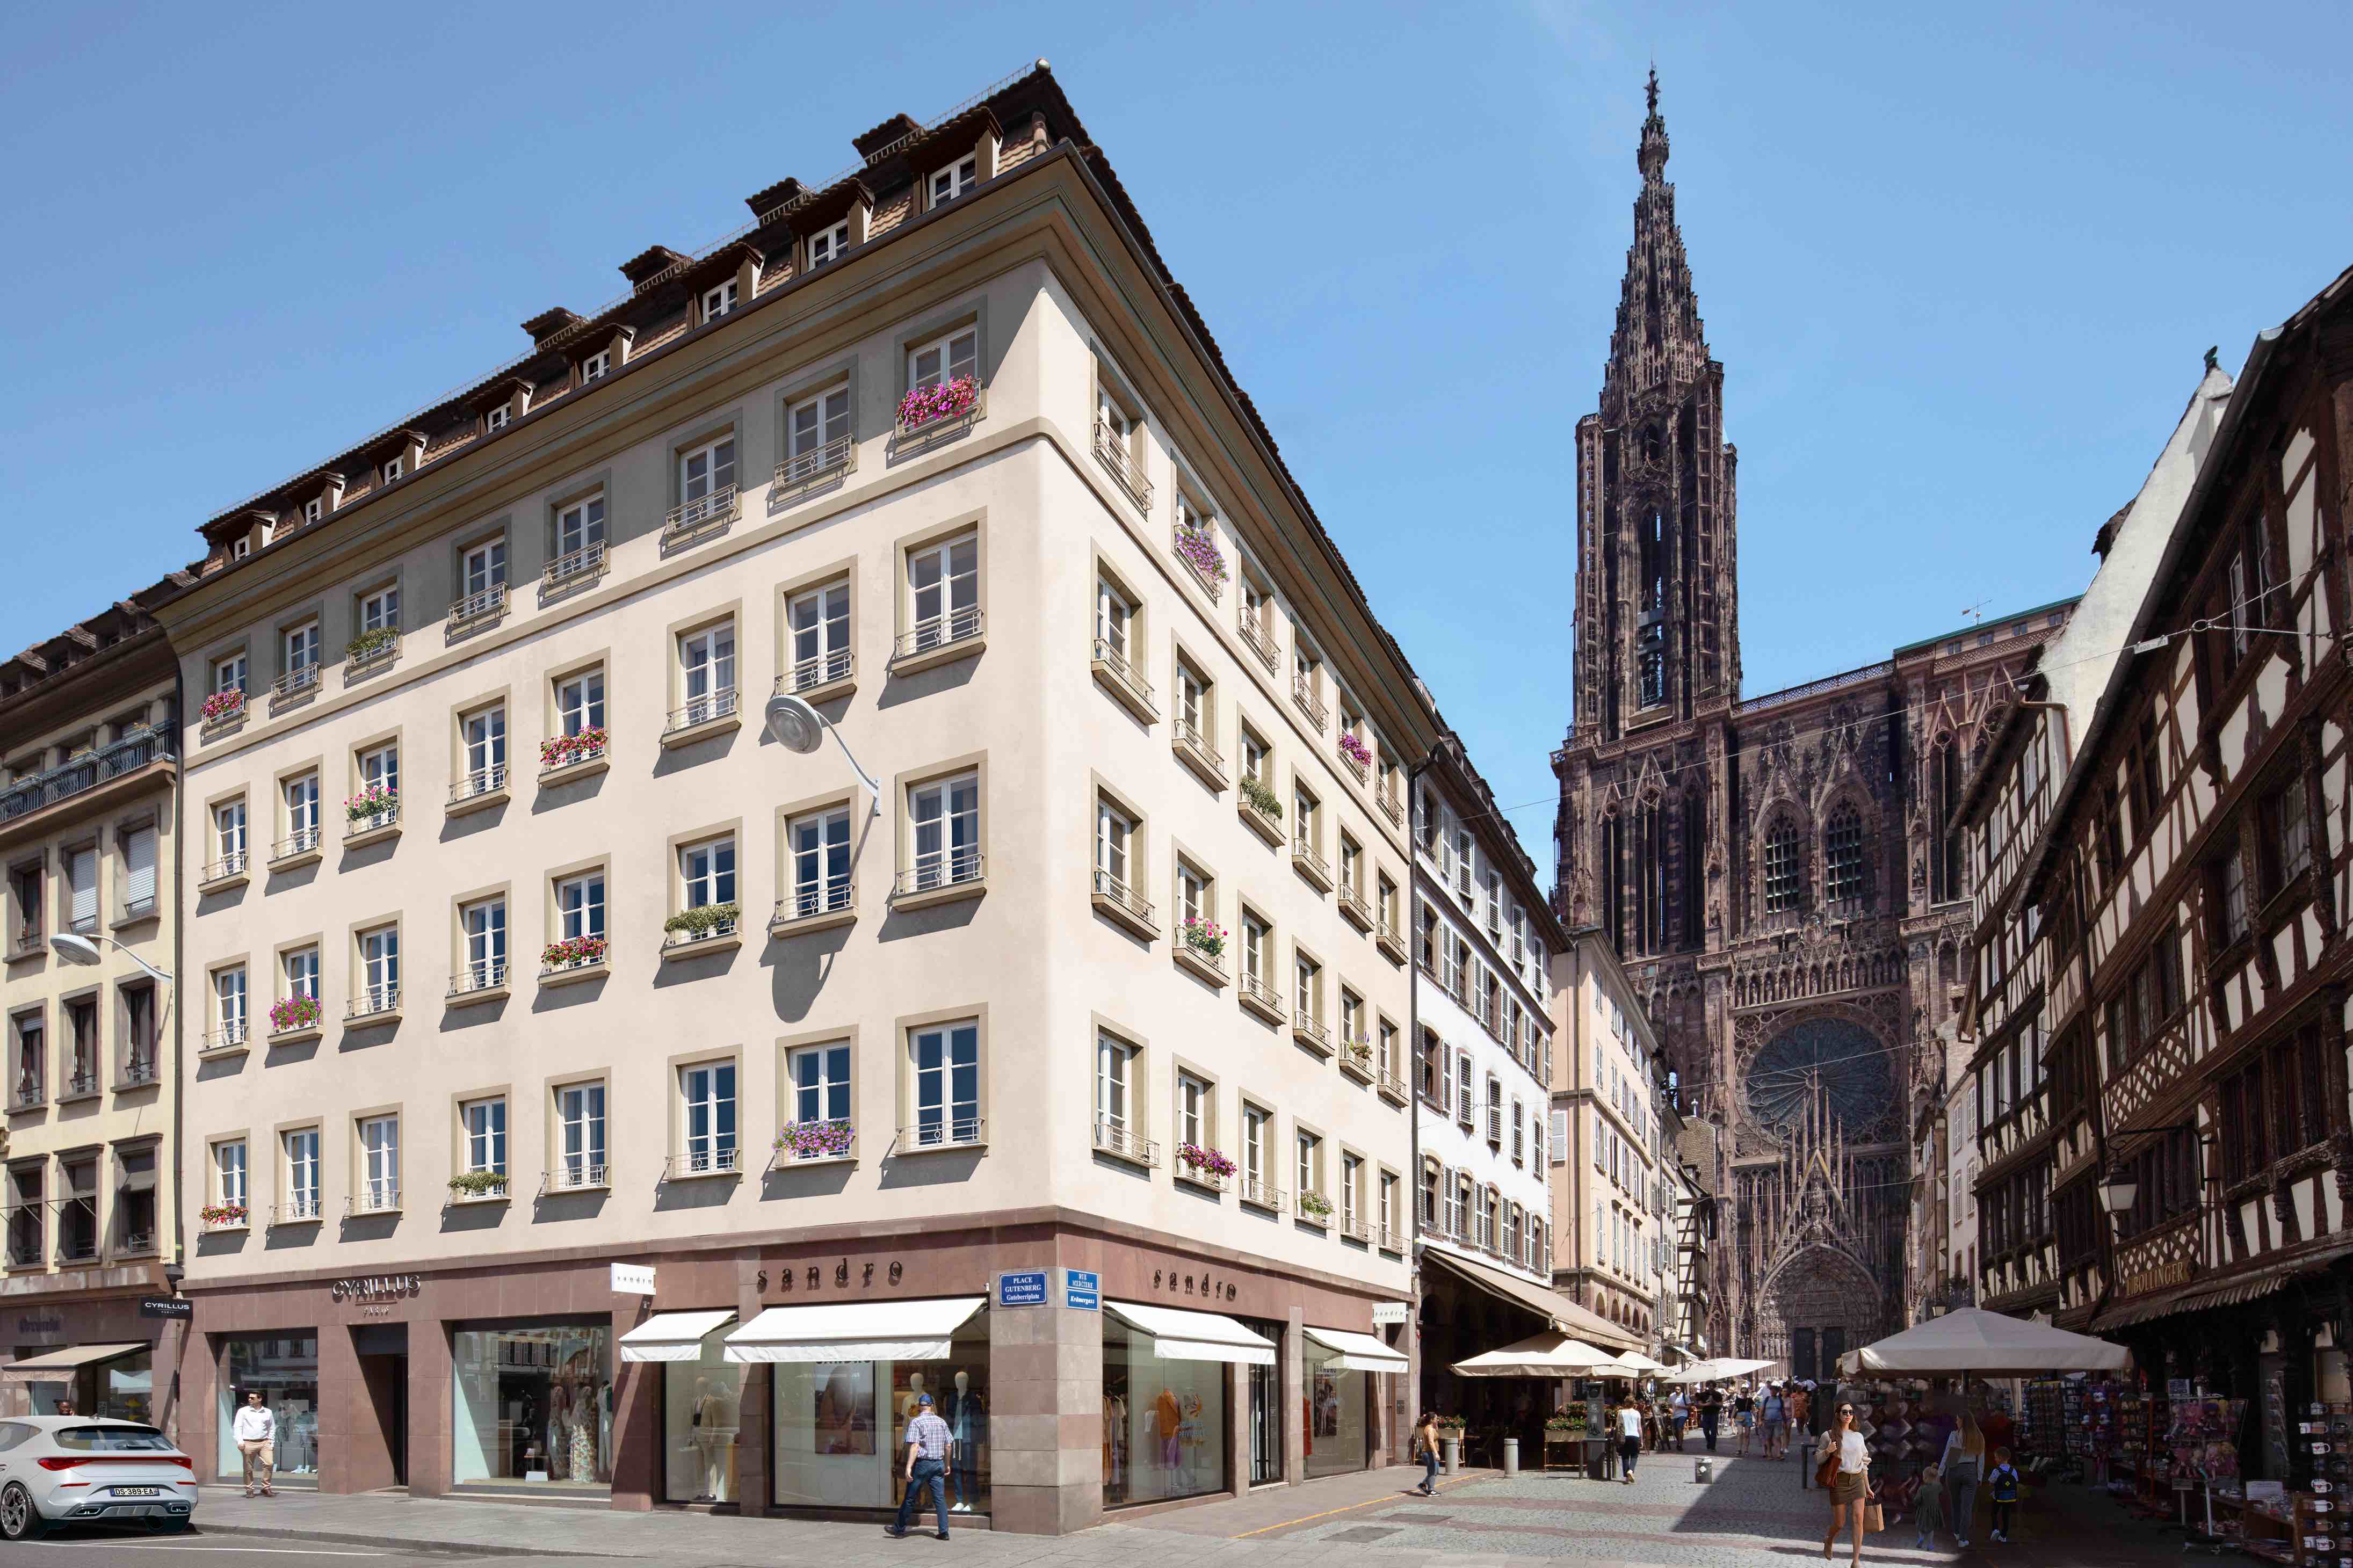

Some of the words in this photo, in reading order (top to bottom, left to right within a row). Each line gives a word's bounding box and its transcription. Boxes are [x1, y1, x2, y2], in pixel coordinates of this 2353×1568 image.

[757, 1258, 903, 1285] sandro
[1154, 1269, 1236, 1296] sandro
[332, 1275, 421, 1296] CYRILLUS
[364, 1305, 390, 1314] PARIS
